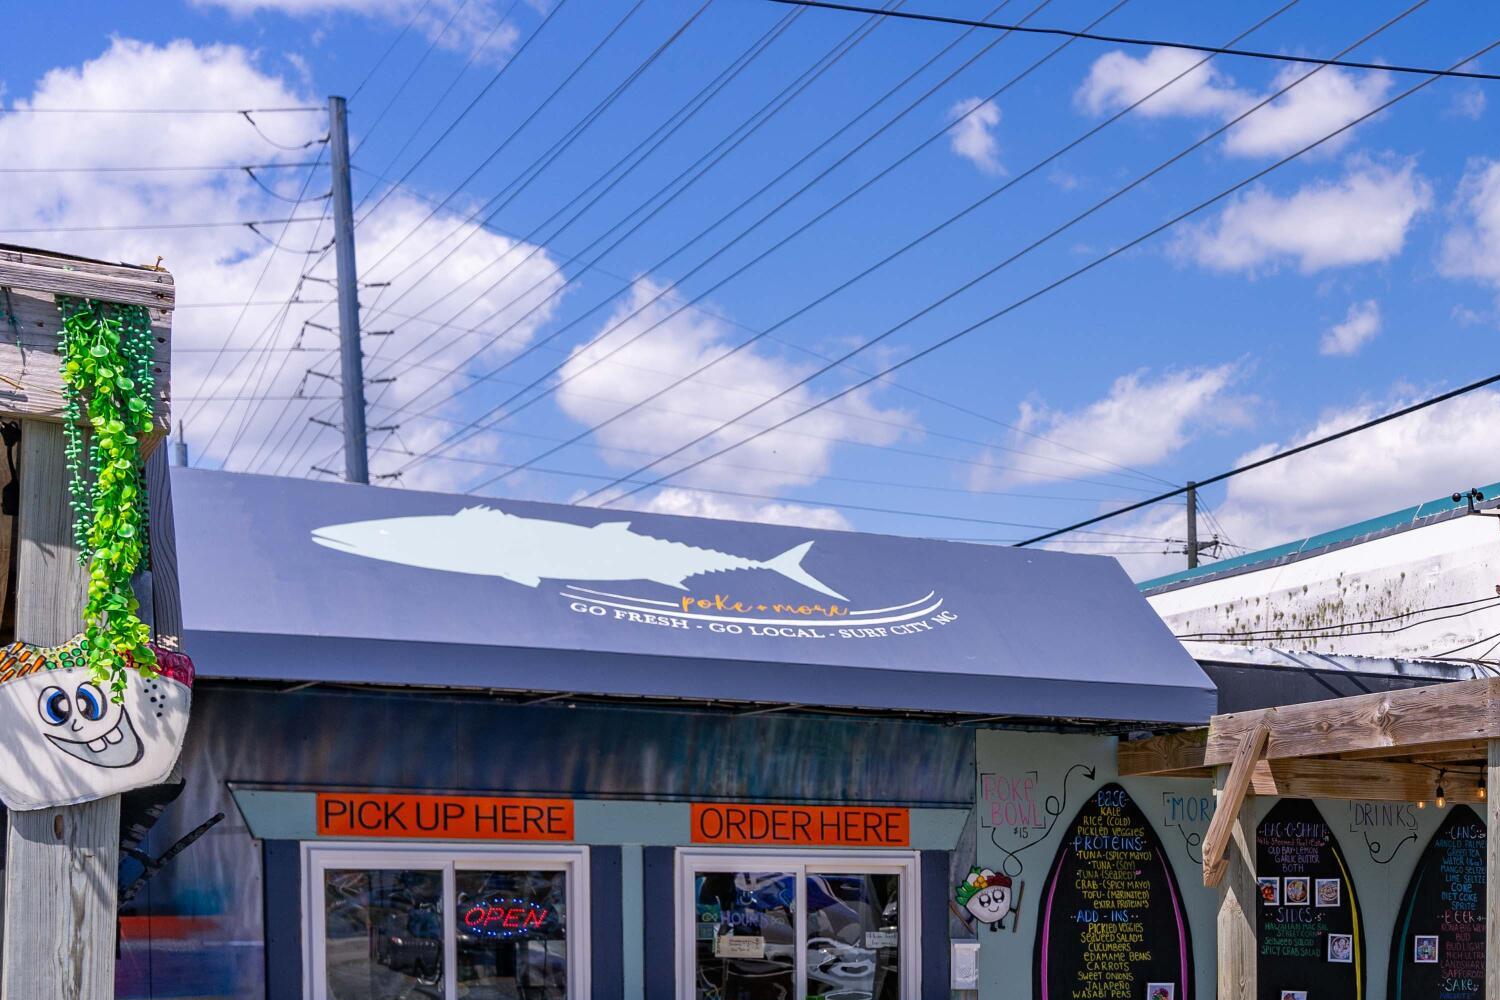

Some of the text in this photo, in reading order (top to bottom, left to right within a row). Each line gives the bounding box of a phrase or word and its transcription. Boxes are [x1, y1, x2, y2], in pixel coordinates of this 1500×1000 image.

[681, 594, 752, 614] poke
[773, 602, 849, 617] more
[570, 601, 607, 617] GO
[613, 610, 689, 629] FRESH
[709, 622, 743, 635] GO
[751, 624, 825, 640] LOCAL
[839, 625, 887, 640] SURF
[890, 620, 932, 637] CITY
[933, 610, 958, 632] NC
[324, 800, 568, 835] PICK UP HERE
[992, 801, 1042, 827] BOWL
[1170, 796, 1216, 821] MOR
[1355, 803, 1416, 828] DRINKS
[700, 809, 903, 844] ORDER HERE
[1013, 827, 1029, 839] $15
[1282, 863, 1304, 873] BOTH
[465, 906, 549, 930] OPEN
[1076, 910, 1099, 922] ADD
[1111, 909, 1129, 922] INS
[1086, 961, 1130, 972] CARROTS
[1129, 951, 1152, 961] BEANS
[1105, 972, 1134, 982] ONIONS
[1072, 990, 1107, 999] WASABI
